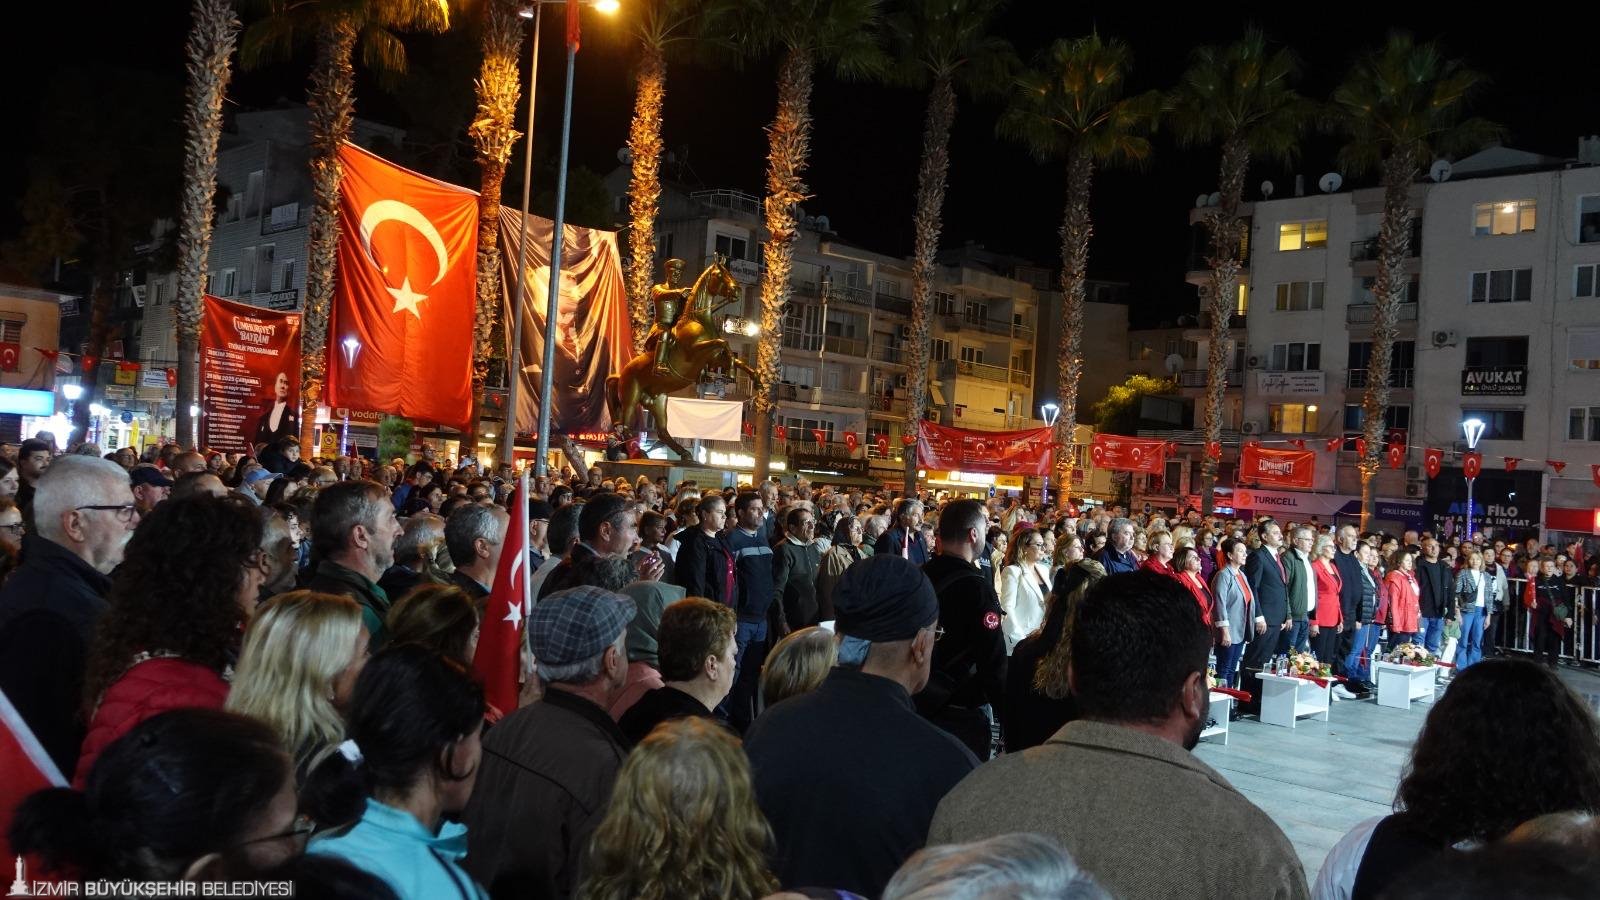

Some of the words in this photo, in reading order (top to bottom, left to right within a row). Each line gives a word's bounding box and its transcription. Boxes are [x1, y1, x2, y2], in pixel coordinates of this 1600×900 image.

[240, 331, 270, 344] BAYRAMI
[1465, 370, 1522, 383] AVUKAT
[1254, 495, 1298, 506] TURKCELL
[1400, 509, 1420, 517] EXTRA
[1487, 503, 1518, 517] FİLO
